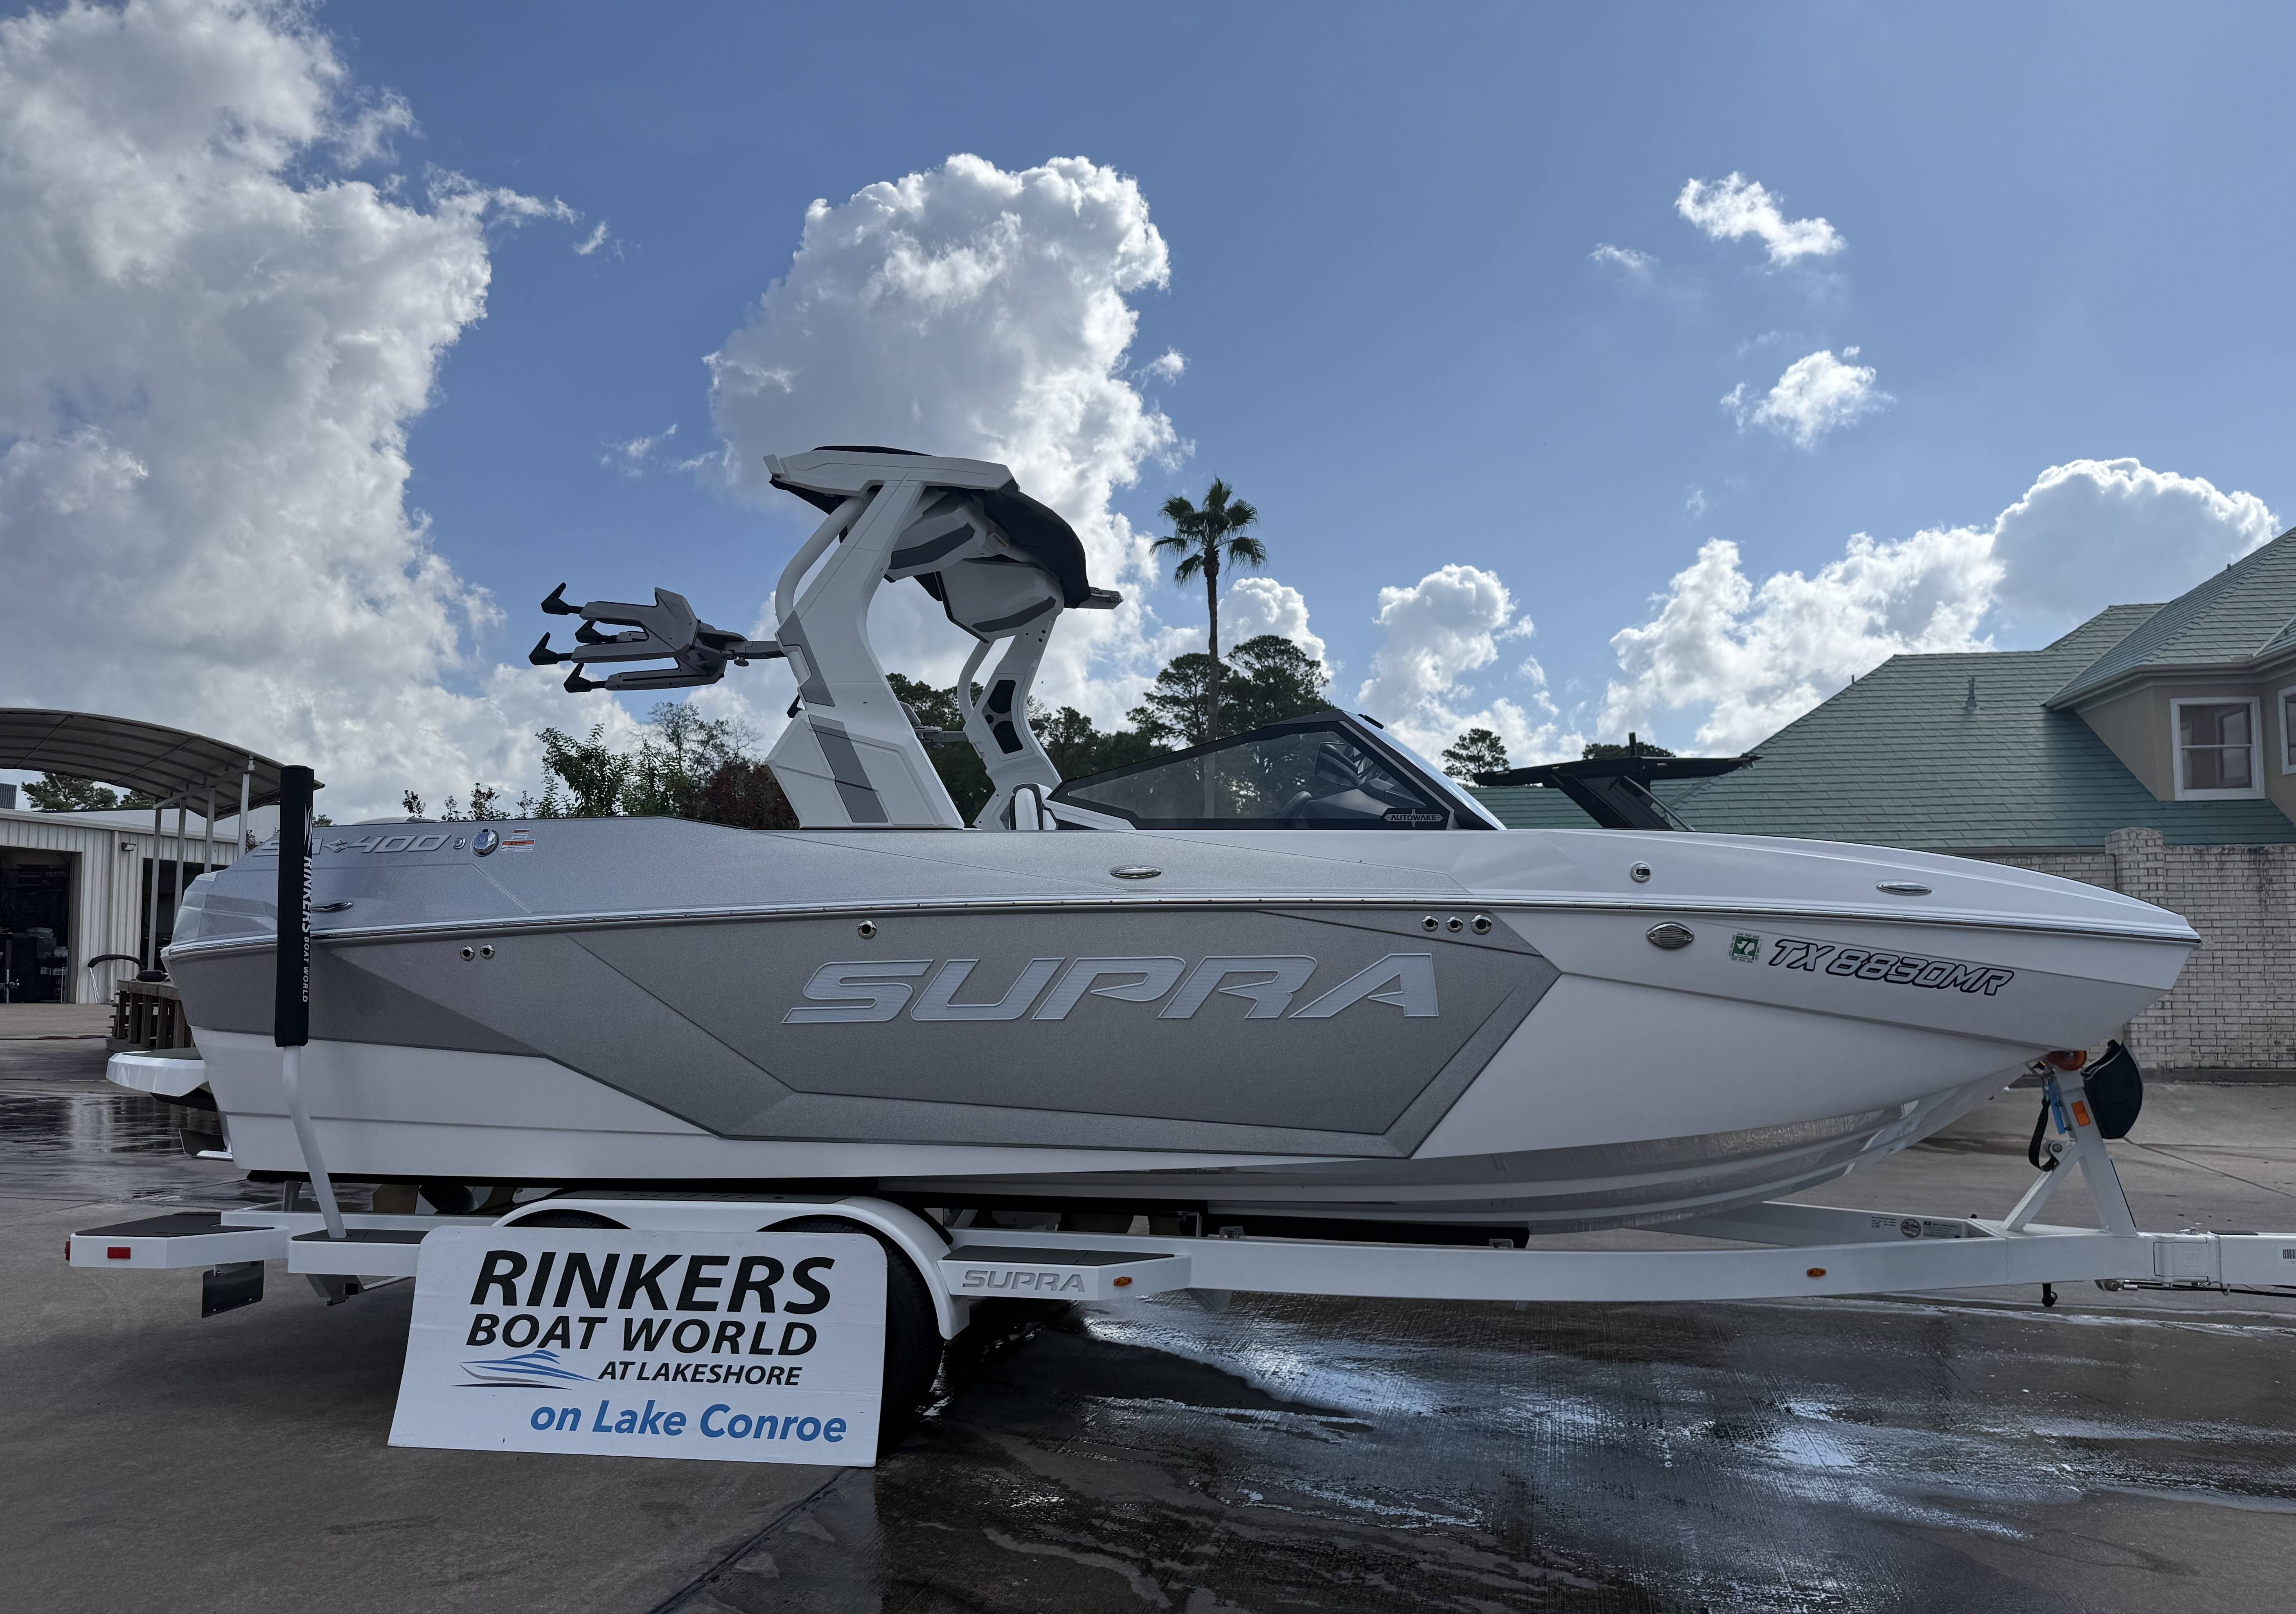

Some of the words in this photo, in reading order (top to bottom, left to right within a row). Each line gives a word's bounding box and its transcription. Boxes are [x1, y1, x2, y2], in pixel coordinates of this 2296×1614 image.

[347, 833, 452, 853] 400
[302, 856, 312, 933] RINKERS
[782, 953, 1439, 1023] SUPRA
[1768, 939, 1835, 972] TX
[1825, 948, 2014, 996] 8830MR
[470, 1250, 835, 1315] RINKERS
[962, 1270, 1086, 1293] SUPRA
[466, 1313, 608, 1349] BOAT
[623, 1318, 817, 1356] WORLD
[597, 1361, 636, 1380] AT
[636, 1362, 803, 1386] LAKESHORE
[530, 1407, 582, 1432] on
[592, 1400, 687, 1436] Lake
[700, 1404, 847, 1443] Conroe
